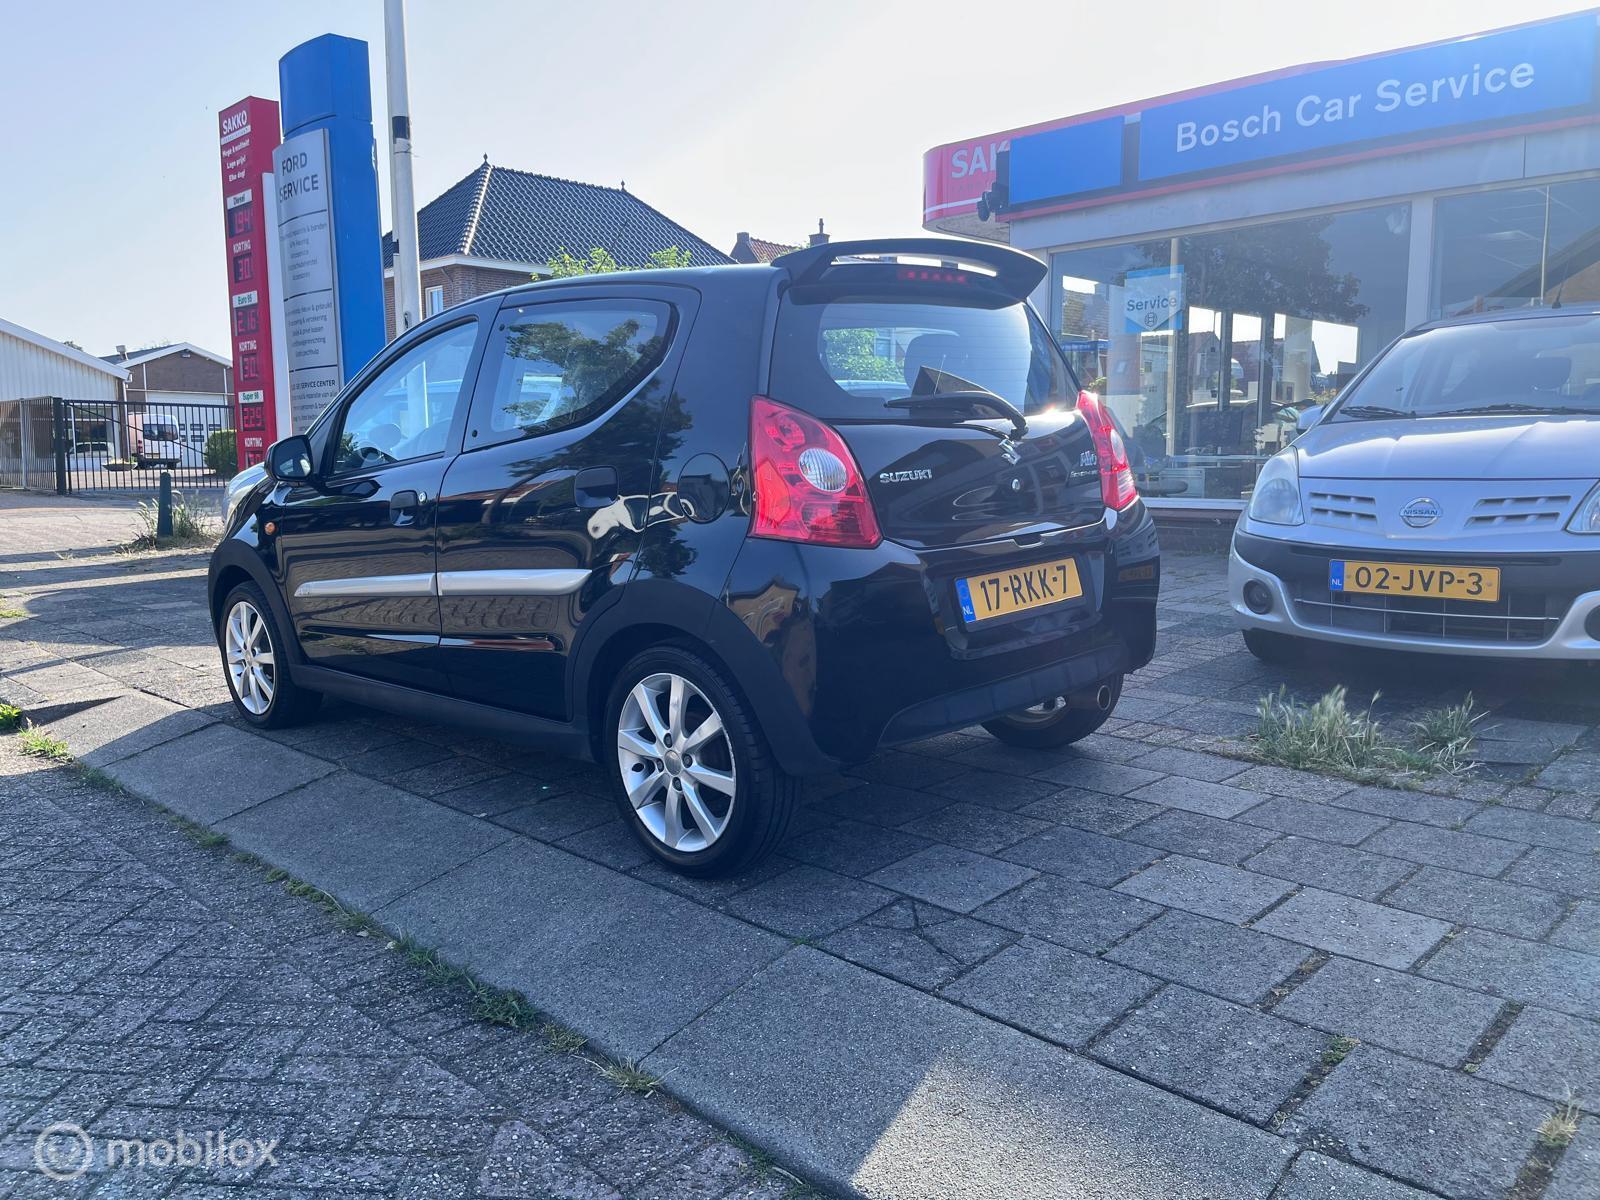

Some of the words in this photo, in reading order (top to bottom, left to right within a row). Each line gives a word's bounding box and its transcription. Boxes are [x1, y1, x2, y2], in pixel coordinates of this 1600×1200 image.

[1176, 104, 1281, 152] Bosch
[1295, 91, 1362, 127] Car
[1374, 62, 1535, 113] Service
[222, 110, 247, 135] SAKKO
[281, 152, 307, 176] FORD
[279, 173, 319, 203] SERVICE
[233, 194, 245, 205] Diesel
[233, 239, 251, 254] KORTING
[238, 295, 247, 305] Euro
[1127, 294, 1177, 312] Service
[239, 339, 257, 352] KORTING
[300, 381, 316, 389] SERVICE
[316, 379, 336, 388] CENTER
[242, 393, 253, 401] Super
[253, 391, 259, 400] 98
[244, 437, 262, 447] KORTING
[879, 468, 933, 484] SUZUKI
[1331, 578, 1343, 586] NL
[1354, 566, 1483, 596] 02-JVP-3
[962, 605, 973, 615] NL
[980, 564, 1067, 612] 17-RKK-7
